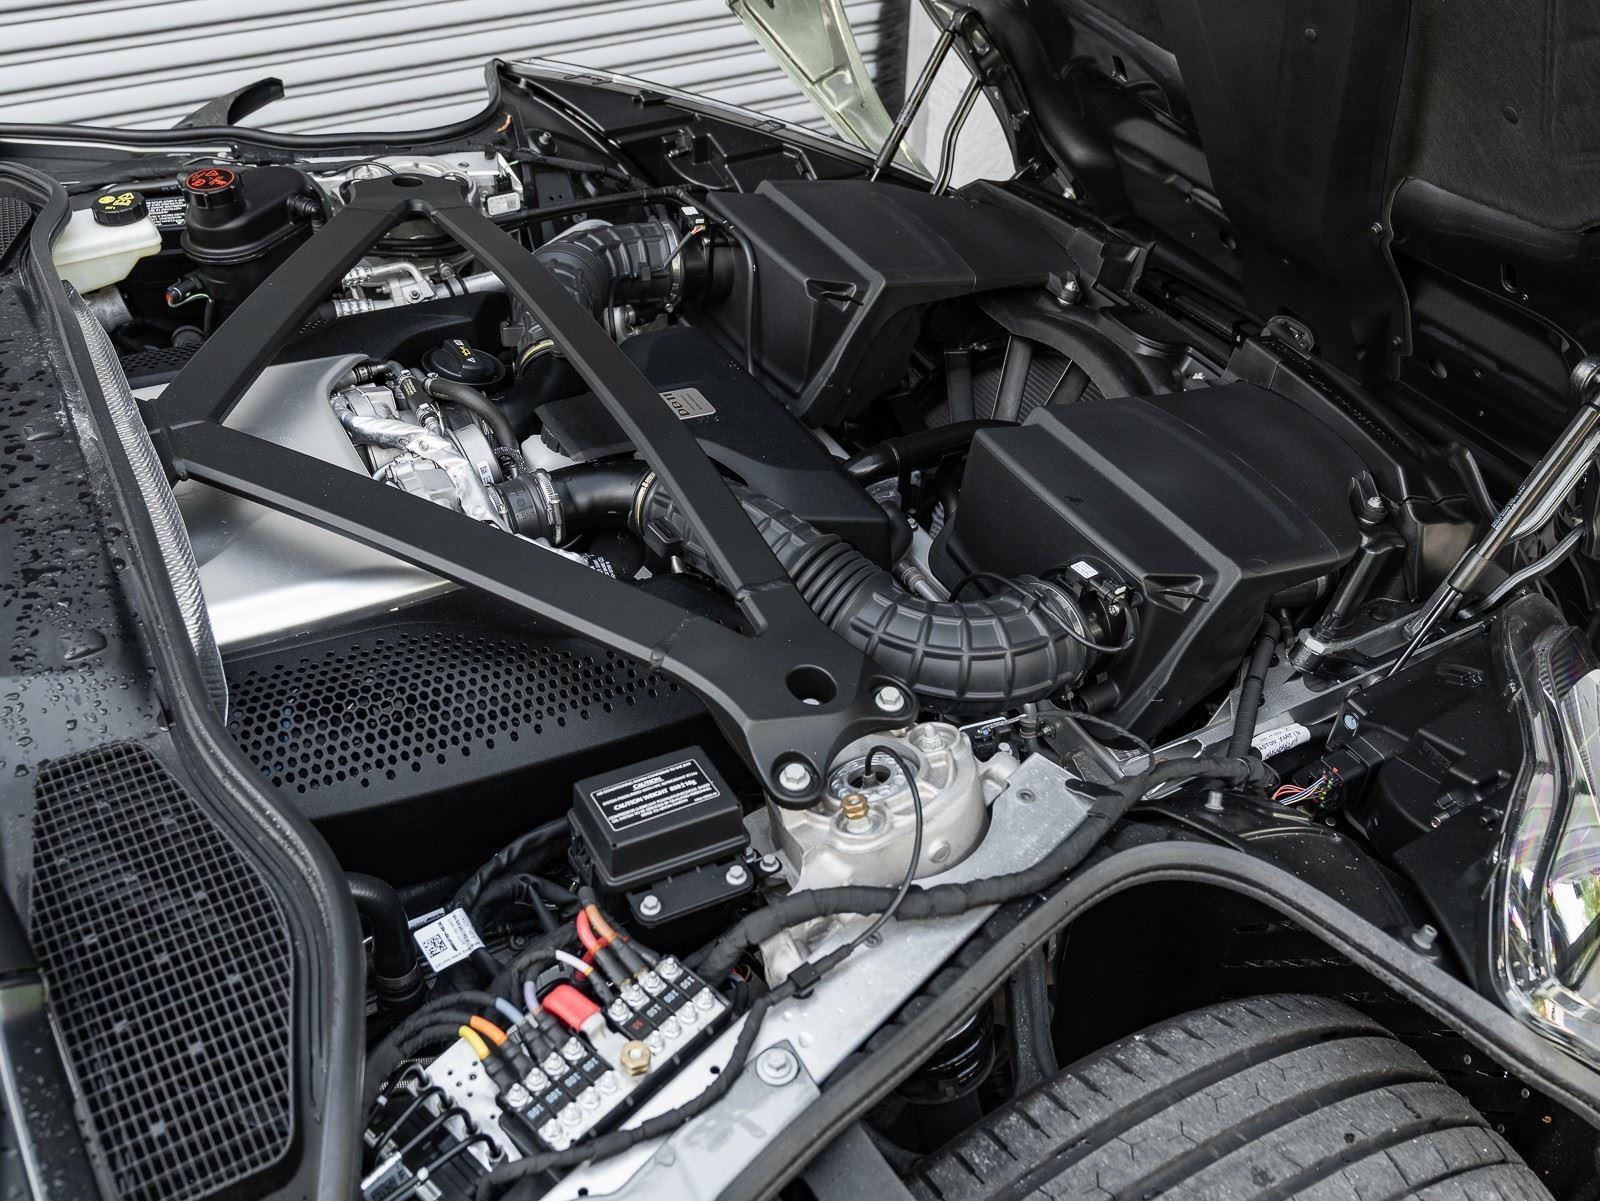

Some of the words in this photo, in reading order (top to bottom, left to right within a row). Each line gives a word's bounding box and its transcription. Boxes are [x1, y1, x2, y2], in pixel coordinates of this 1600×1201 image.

[663, 393, 690, 416] DB11
[613, 796, 643, 811] CAUTION
[643, 787, 668, 802] WEIGHT
[583, 1058, 598, 1072] 100
[565, 1072, 581, 1087] 100
[546, 1088, 562, 1104] 100
[528, 1103, 544, 1120] 100
